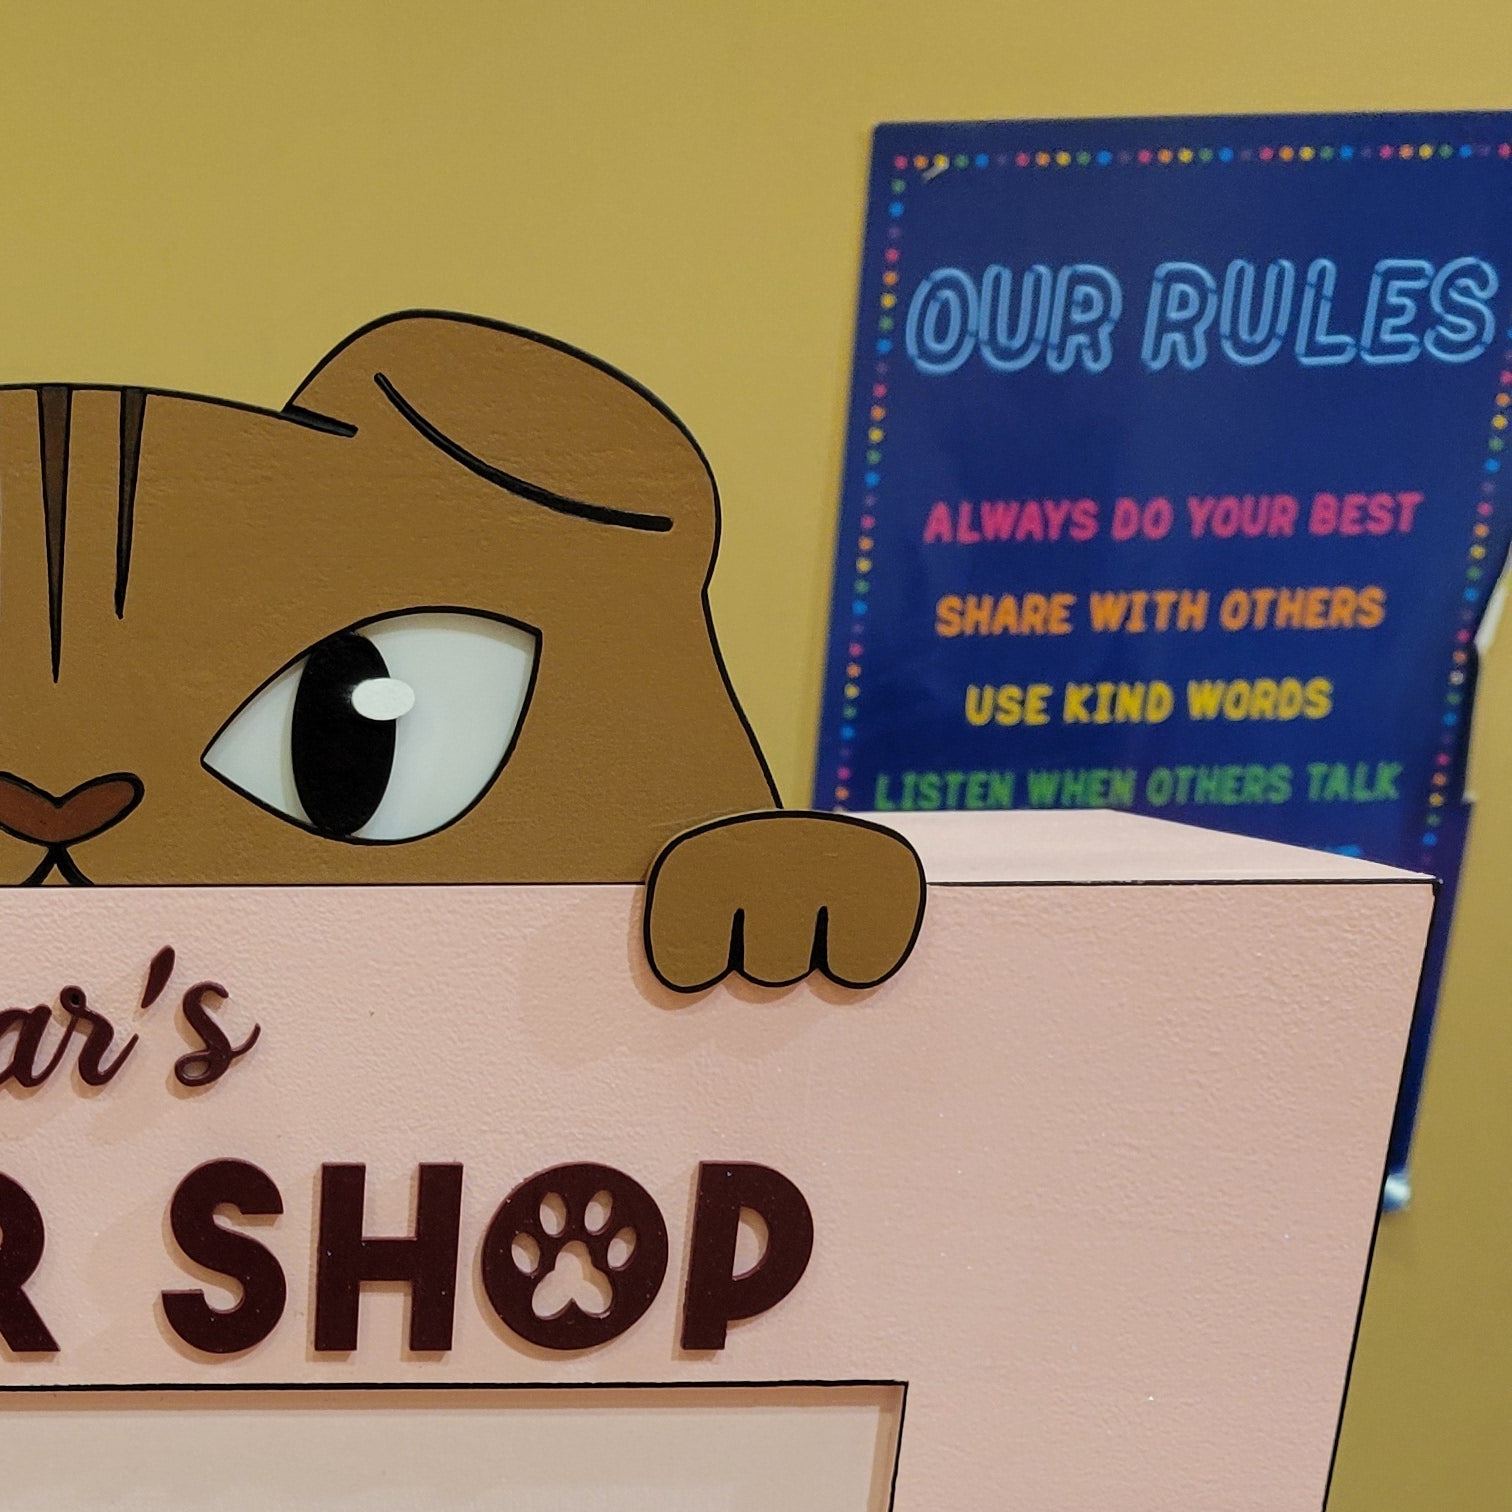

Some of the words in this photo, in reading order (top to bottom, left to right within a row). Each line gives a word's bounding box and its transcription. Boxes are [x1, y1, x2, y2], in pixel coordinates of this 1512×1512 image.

[905, 264, 1123, 375] OUR
[1141, 257, 1499, 373] RULES
[922, 499, 1100, 544] ALWAYS
[1111, 497, 1173, 540] DO
[1188, 495, 1299, 537] YOUR
[1308, 491, 1425, 536] BEST
[935, 593, 1077, 638] SHARE
[1090, 590, 1209, 634] WITH
[1219, 586, 1386, 631] OTHERS
[964, 684, 1052, 726] USE
[1063, 681, 1173, 725] KIND
[1187, 677, 1334, 721] WORDS
[874, 768, 1014, 811] LISTEN
[1026, 767, 1136, 809] WHEN
[1146, 764, 1292, 806] OTHERS
[1307, 761, 1404, 803] TALK
[160, 1156, 815, 1354] SHOP
